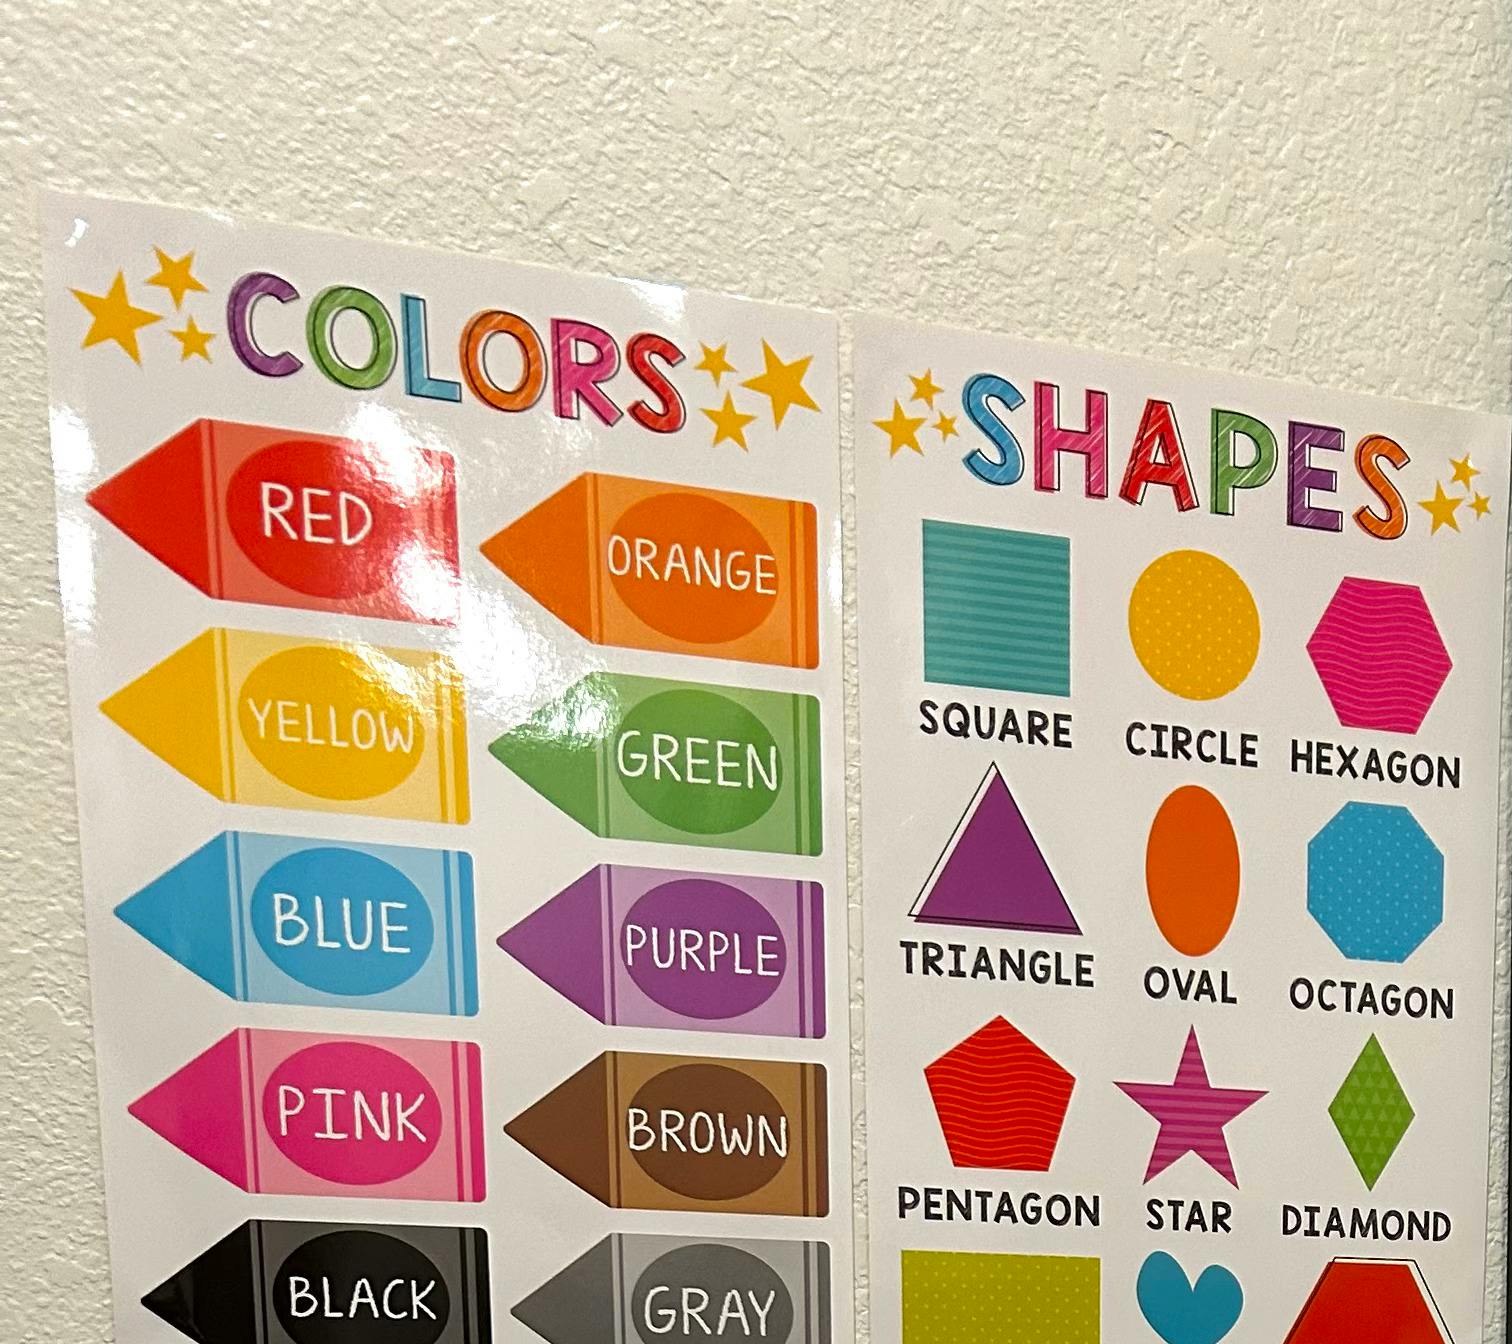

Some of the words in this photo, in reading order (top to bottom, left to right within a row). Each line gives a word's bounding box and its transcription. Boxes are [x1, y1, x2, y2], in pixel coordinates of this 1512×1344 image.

[227, 272, 688, 433] COLORS
[961, 372, 1411, 541] SHAPES
[259, 482, 373, 547] RED
[606, 533, 777, 597] ORANGE
[247, 696, 416, 756] YELLOW
[919, 700, 1073, 749] SQUARE
[1126, 722, 1259, 769] CIRCLE
[616, 729, 779, 791] GREEN
[1291, 739, 1462, 789] HEXAGON
[273, 893, 411, 954] BLUE
[625, 924, 779, 978] PURPLE
[899, 940, 1095, 988] TRIANGLE
[1143, 965, 1238, 1005] OVAL
[1289, 977, 1455, 1020] OCTAGON
[276, 1086, 428, 1144] PINK
[627, 1108, 788, 1158] BROWN
[897, 1186, 1101, 1228] PENTAGON
[1146, 1198, 1233, 1234] STAR
[1281, 1204, 1452, 1242] DIAMOND
[288, 1276, 438, 1321] BLACK
[643, 1284, 777, 1337] GRAY
